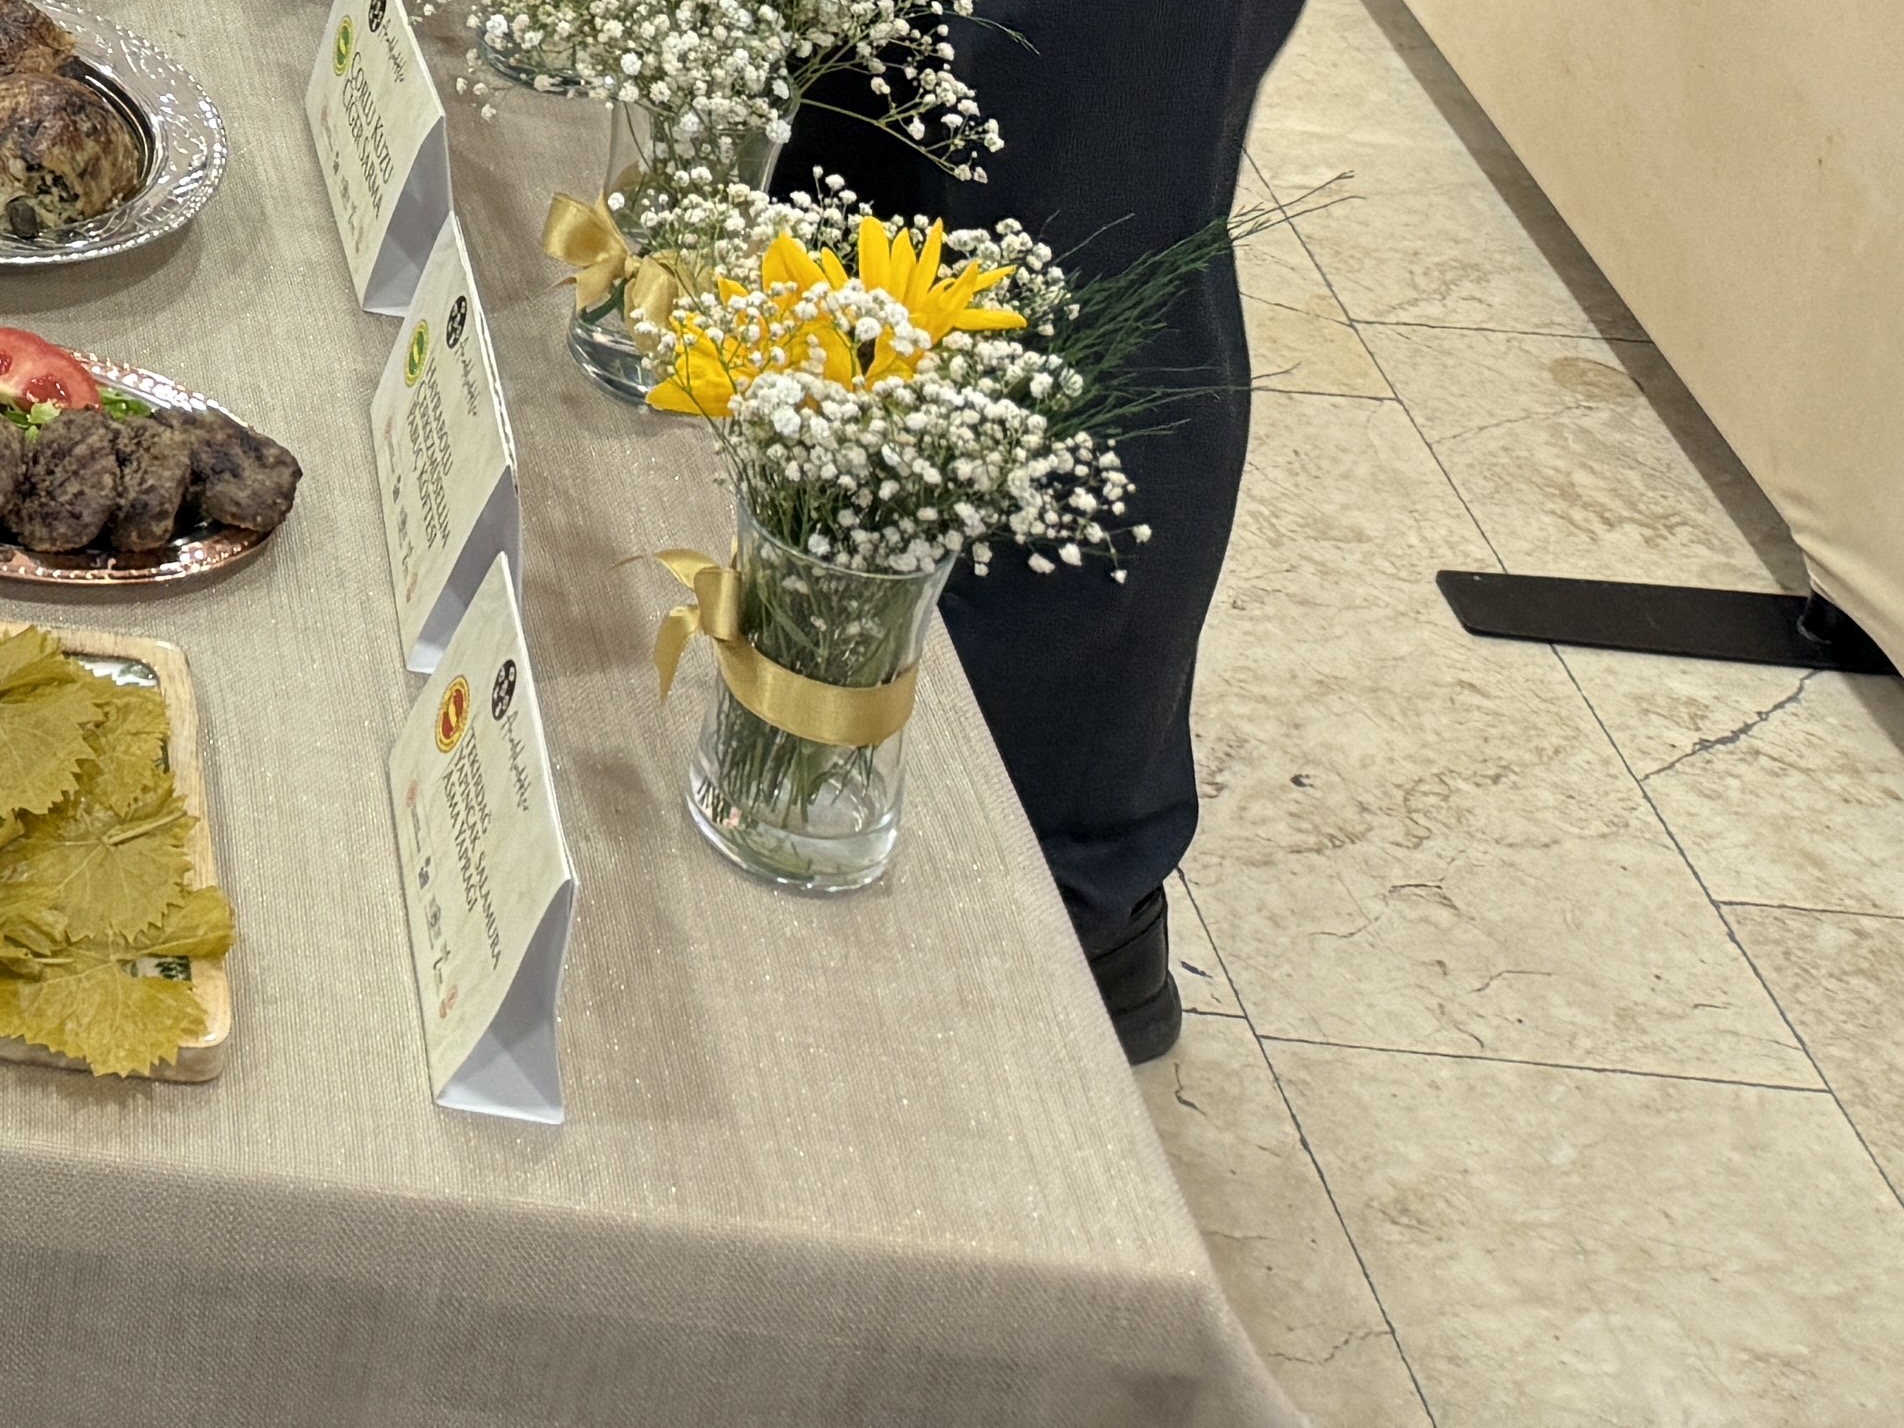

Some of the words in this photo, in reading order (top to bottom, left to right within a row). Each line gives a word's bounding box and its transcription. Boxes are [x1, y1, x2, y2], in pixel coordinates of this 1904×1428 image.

[358, 136, 382, 218] SARMA
[370, 115, 393, 183] KUZU
[465, 727, 491, 833] TEKİRDAĞ
[442, 769, 459, 828] ASMA
[454, 820, 477, 912] YAPRAĞI
[454, 747, 480, 852] YAPINCAK
[475, 851, 500, 969] SALAMURA
